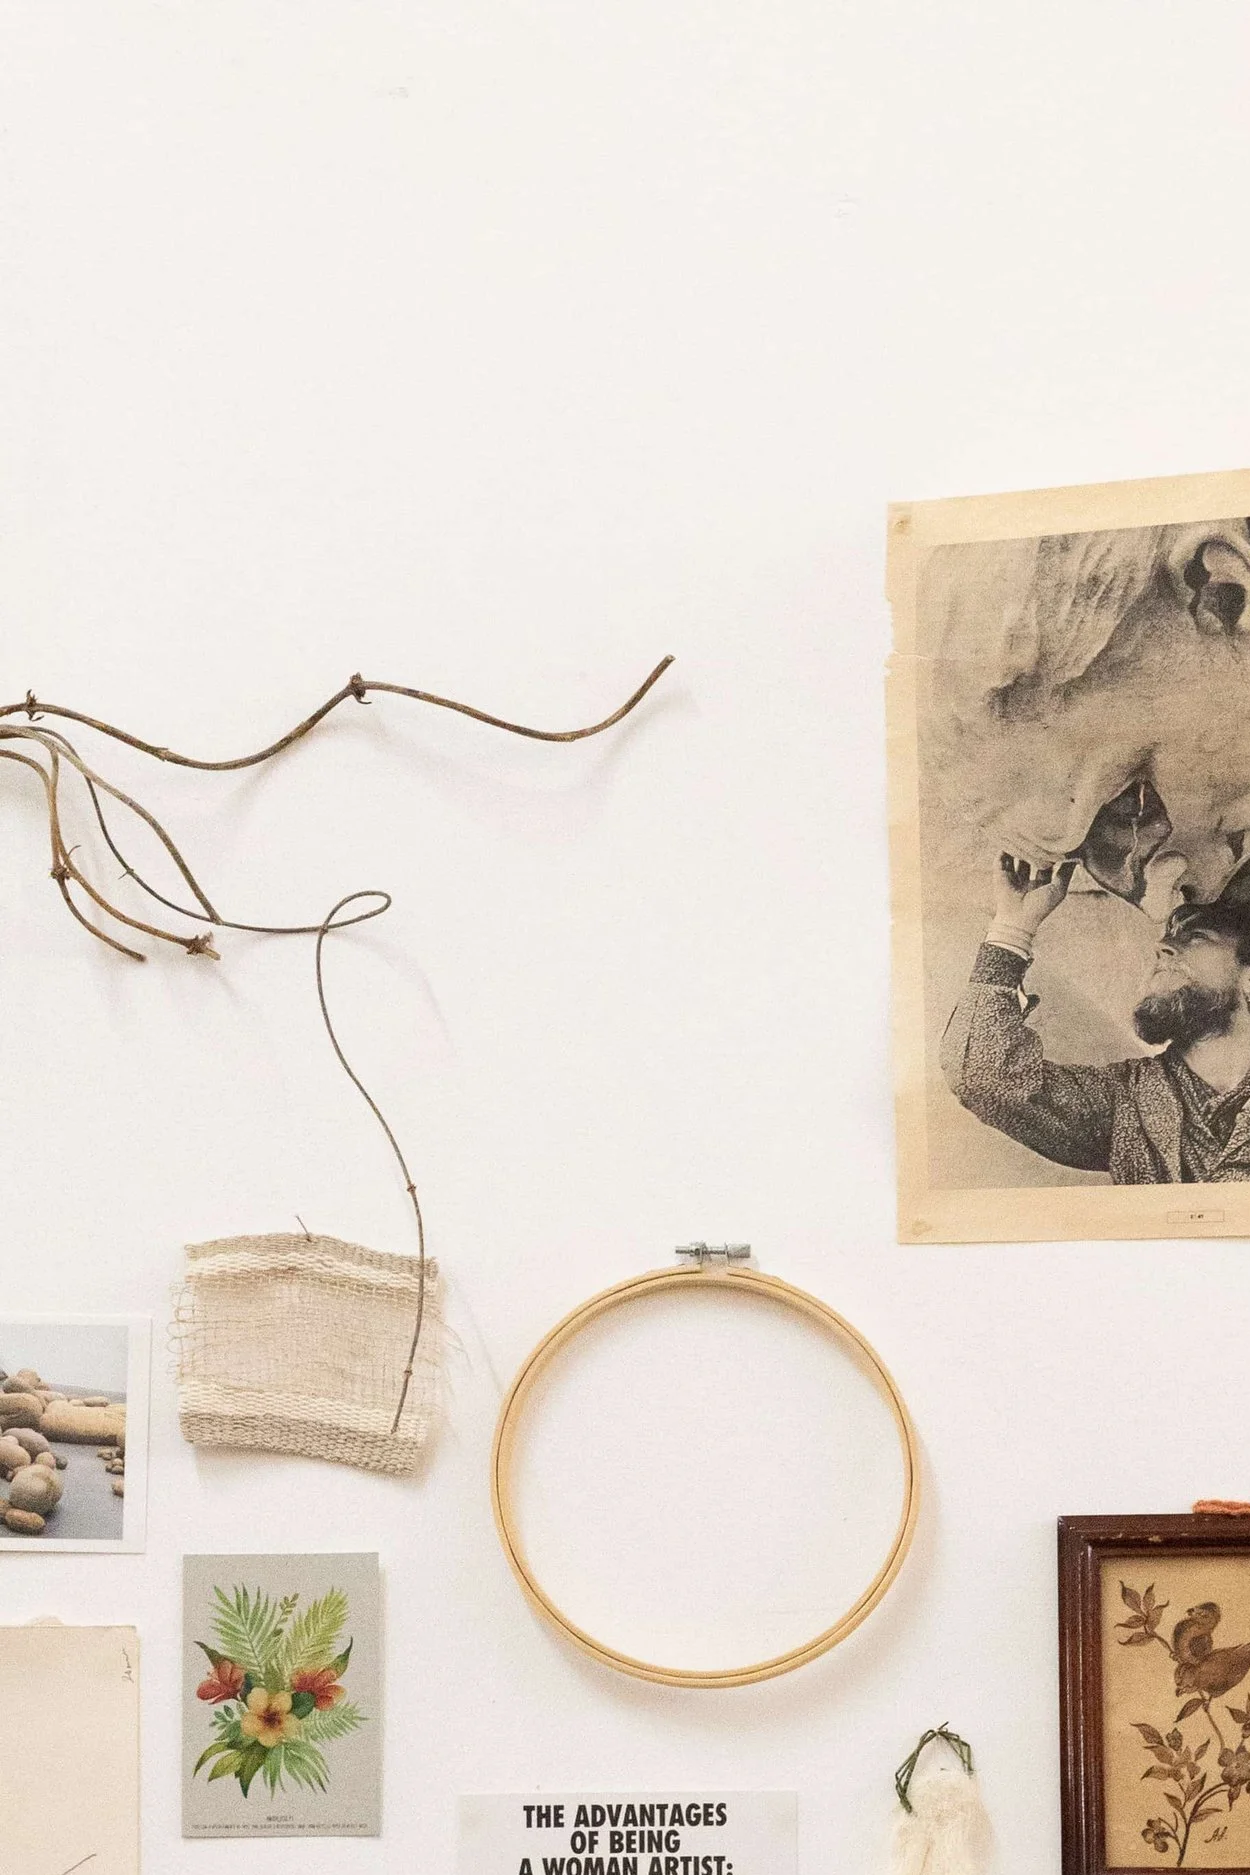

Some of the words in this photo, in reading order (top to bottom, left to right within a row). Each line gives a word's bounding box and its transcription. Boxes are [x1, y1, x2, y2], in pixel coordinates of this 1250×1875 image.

[523, 1804, 565, 1828] THE
[574, 1803, 727, 1827] ADVANTAGES
[570, 1831, 599, 1854] OF
[609, 1830, 681, 1853] BEING
